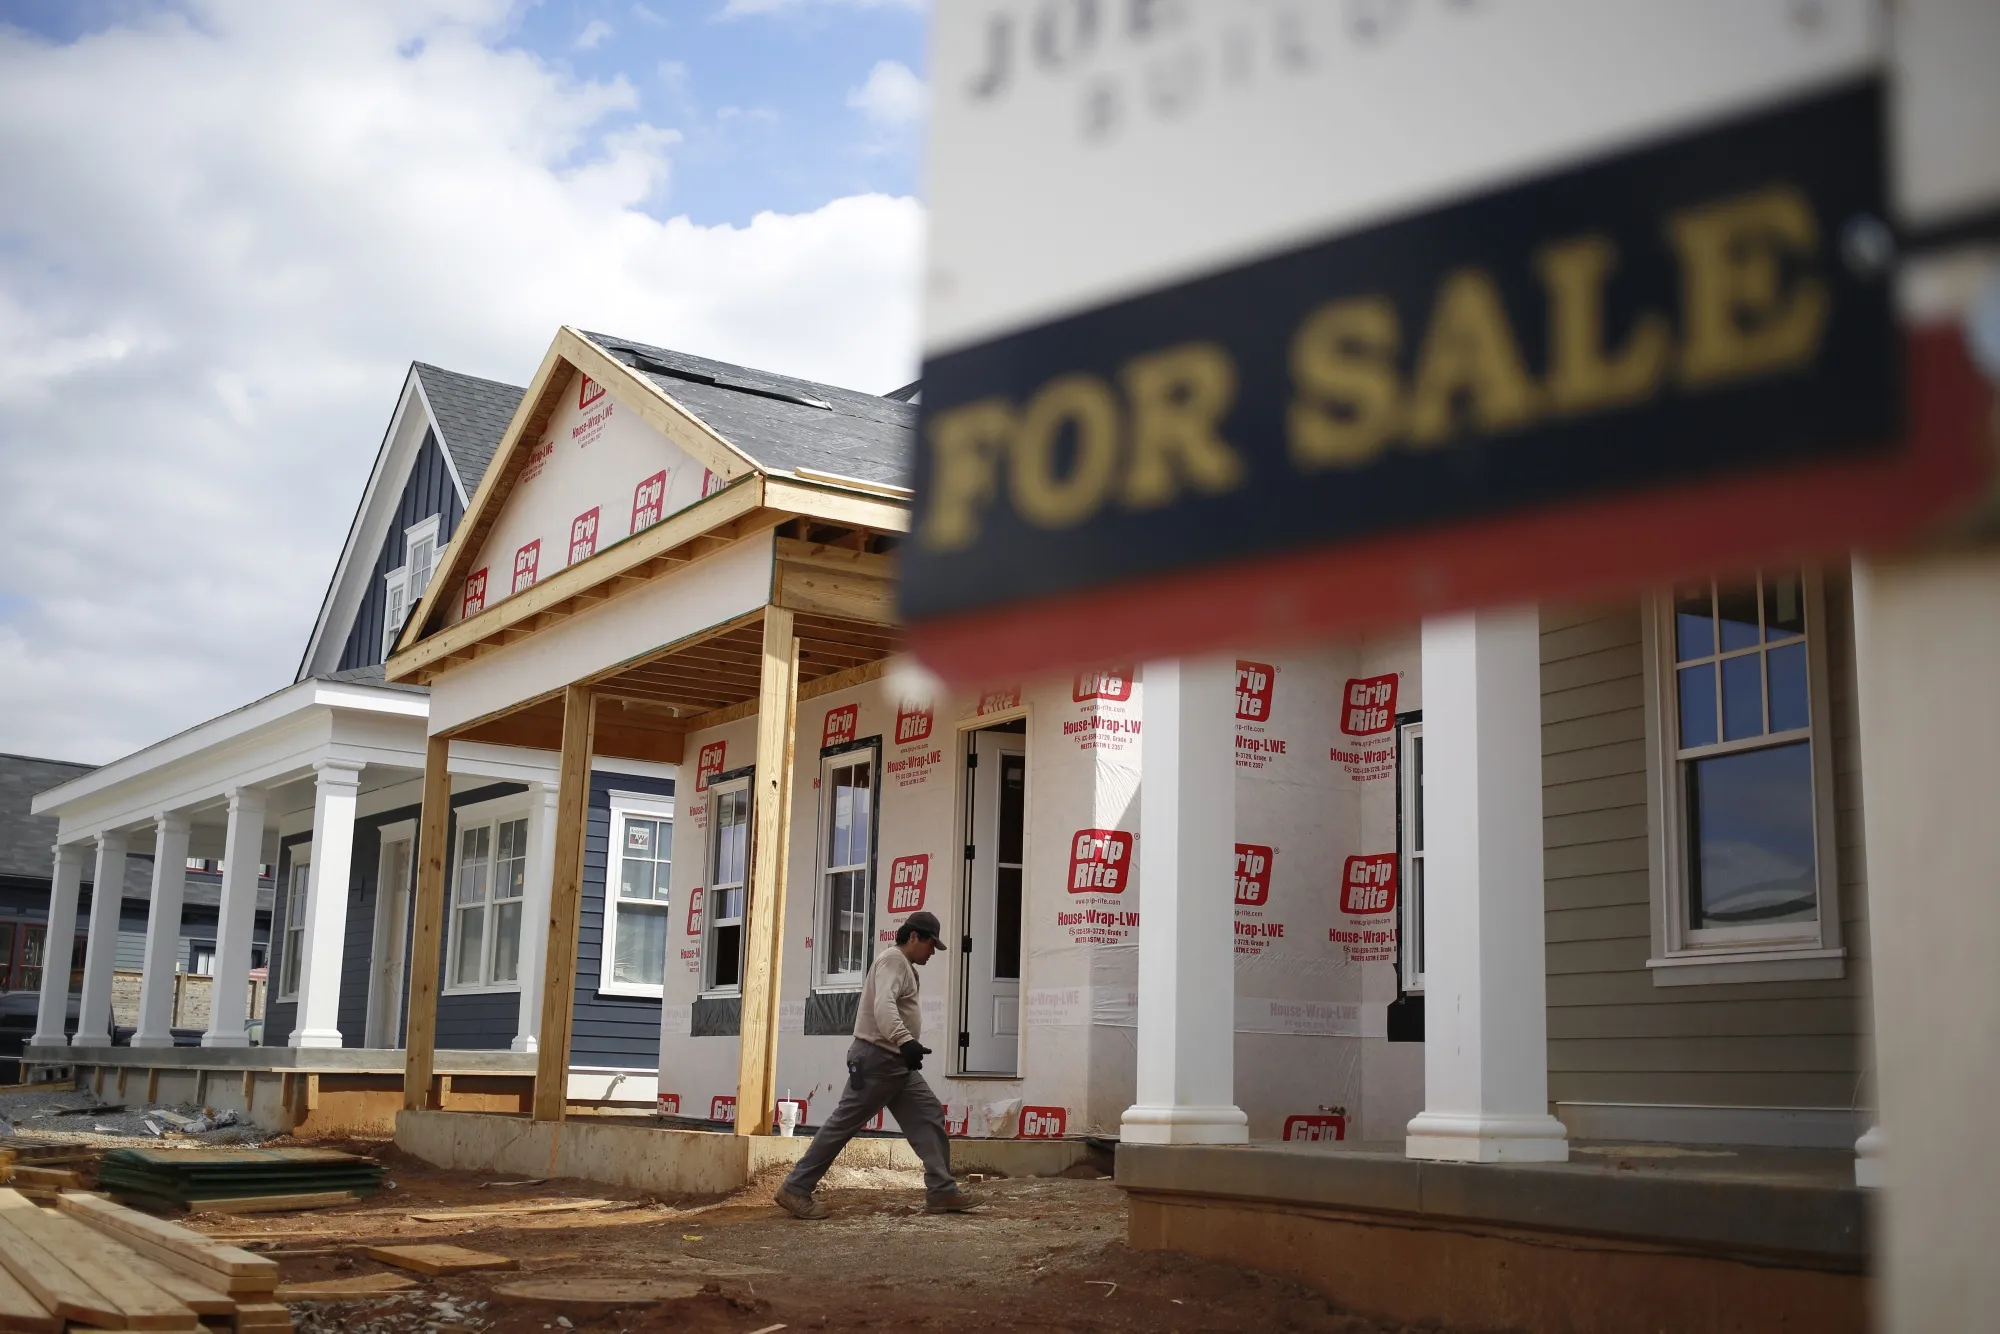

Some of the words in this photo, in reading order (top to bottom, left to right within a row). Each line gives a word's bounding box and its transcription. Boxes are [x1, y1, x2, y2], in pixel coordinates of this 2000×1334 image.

[919, 342, 1243, 552] FOR
[1288, 185, 1830, 472] SALE
[572, 403, 614, 439] House-Wrap-LWE
[636, 480, 661, 510] Grip
[573, 515, 596, 542] Grip
[634, 507, 658, 533] Rite
[516, 546, 537, 572] Grip
[571, 541, 592, 566] Rite
[466, 575, 485, 599] Grip
[514, 571, 534, 593] Rite
[464, 598, 481, 618] Rite
[1079, 668, 1122, 696] Rite
[1235, 667, 1266, 694] rip
[1236, 690, 1262, 717] ite
[1350, 681, 1392, 707] Grip
[828, 710, 854, 734] Grip
[900, 715, 928, 740] Rite
[1063, 715, 1142, 735] House-Wrap-LW
[1348, 707, 1388, 731] Rite
[701, 746, 723, 767] Grip
[1235, 735, 1286, 754] Wrap-LWE
[1330, 747, 1396, 764] House-Wrap-L
[887, 750, 942, 773] House-Wrap-LWE
[1076, 835, 1124, 865] Grip
[895, 860, 924, 885] Grip
[1073, 862, 1118, 888] Rite
[1235, 850, 1265, 877] rip
[1349, 860, 1392, 886] Grip
[892, 886, 920, 908] Rite
[1234, 876, 1260, 900] ite
[1347, 886, 1388, 910] Rite
[1329, 928, 1397, 945] House-Wrap-L
[1270, 1002, 1358, 1021] House-Wrap-LWE
[1024, 1111, 1060, 1138] Grip
